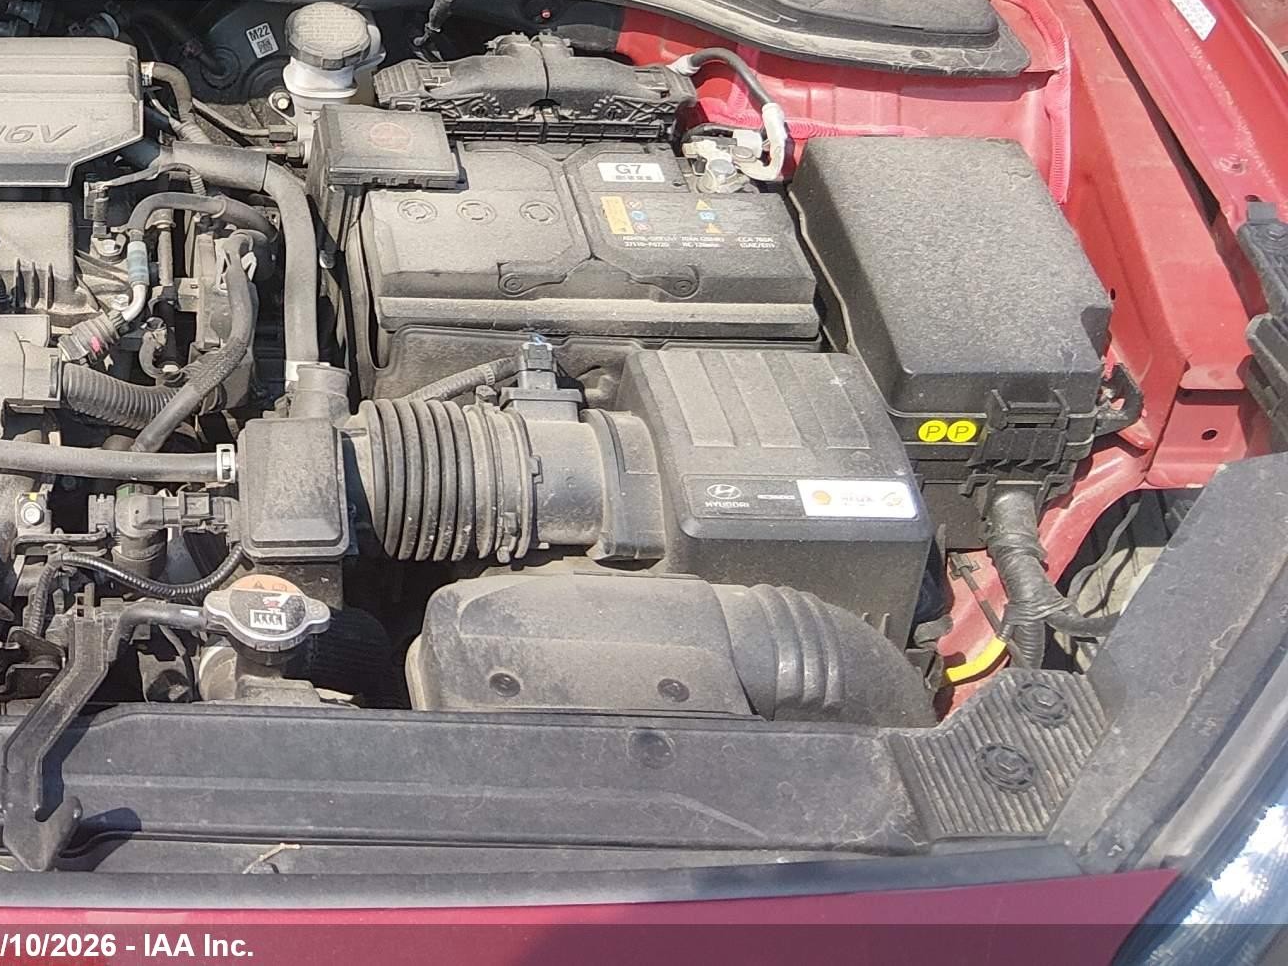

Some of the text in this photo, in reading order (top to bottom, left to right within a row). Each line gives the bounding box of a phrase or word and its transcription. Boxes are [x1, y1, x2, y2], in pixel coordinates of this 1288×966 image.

[248, 25, 271, 42] M22
[615, 163, 643, 176] G7
[925, 425, 970, 440] P P
[704, 500, 750, 509] HYUNDAI
